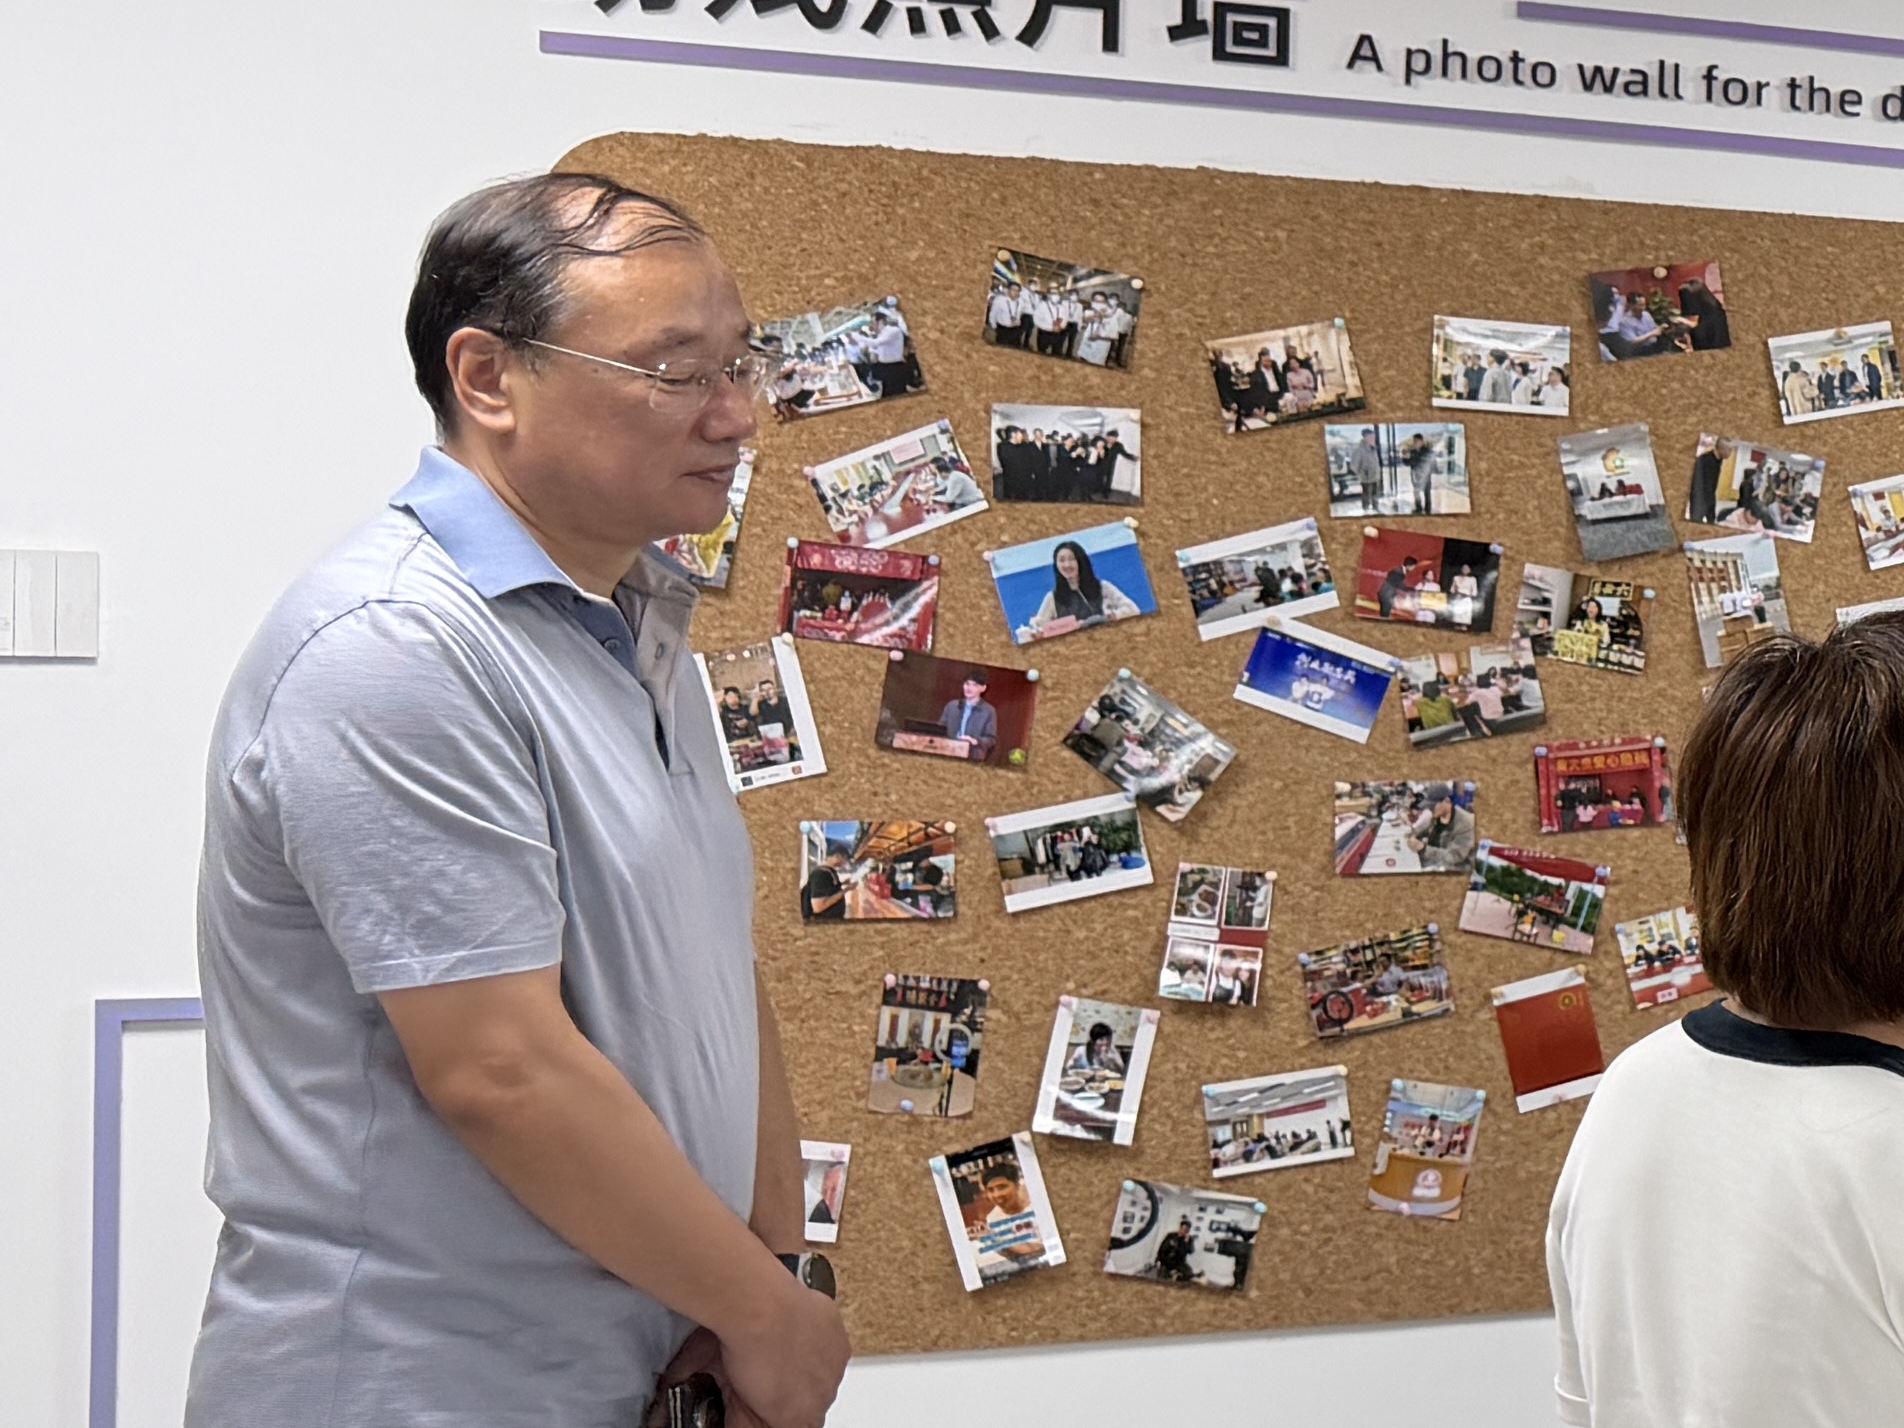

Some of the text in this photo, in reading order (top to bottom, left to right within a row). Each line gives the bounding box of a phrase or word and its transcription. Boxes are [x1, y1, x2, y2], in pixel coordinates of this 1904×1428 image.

[1346, 33, 1384, 73] A
[1403, 38, 1558, 89] photo
[1576, 59, 1683, 102] wall
[1701, 64, 1770, 109] for
[1787, 74, 1863, 118] the
